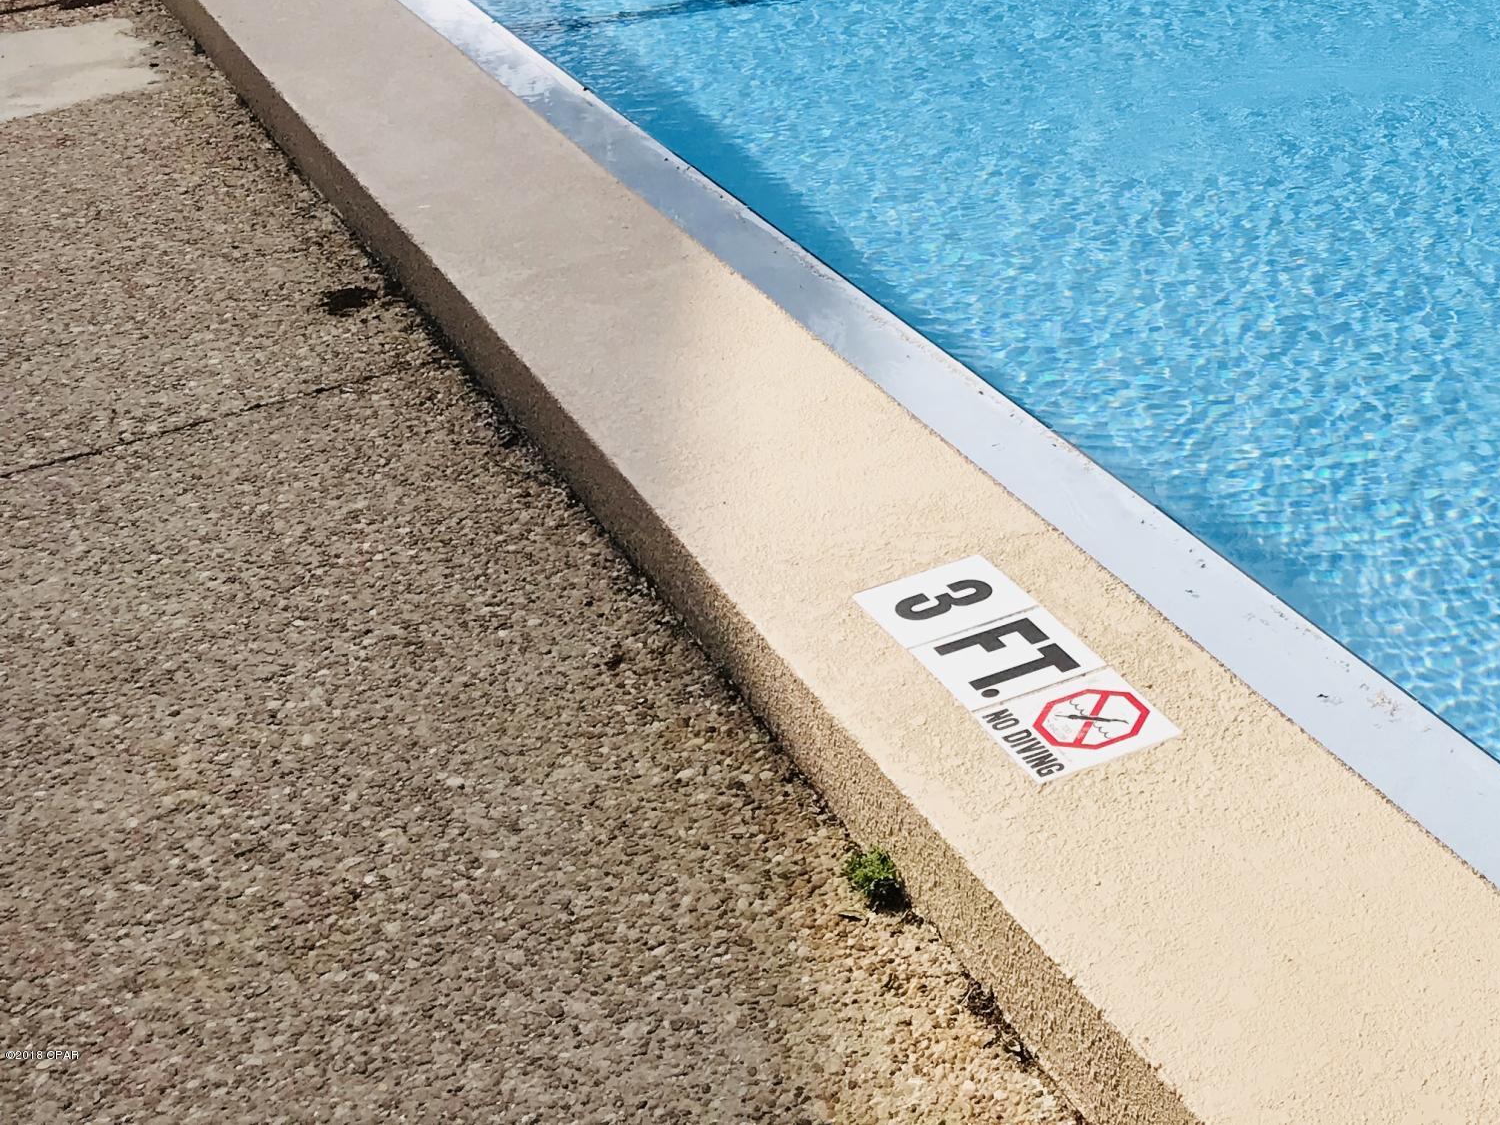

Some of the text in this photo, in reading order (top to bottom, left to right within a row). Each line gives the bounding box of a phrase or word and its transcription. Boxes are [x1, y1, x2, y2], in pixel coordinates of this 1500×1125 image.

[894, 579, 1081, 698] 3 FT.
[982, 708, 1067, 778] NO DIVING
